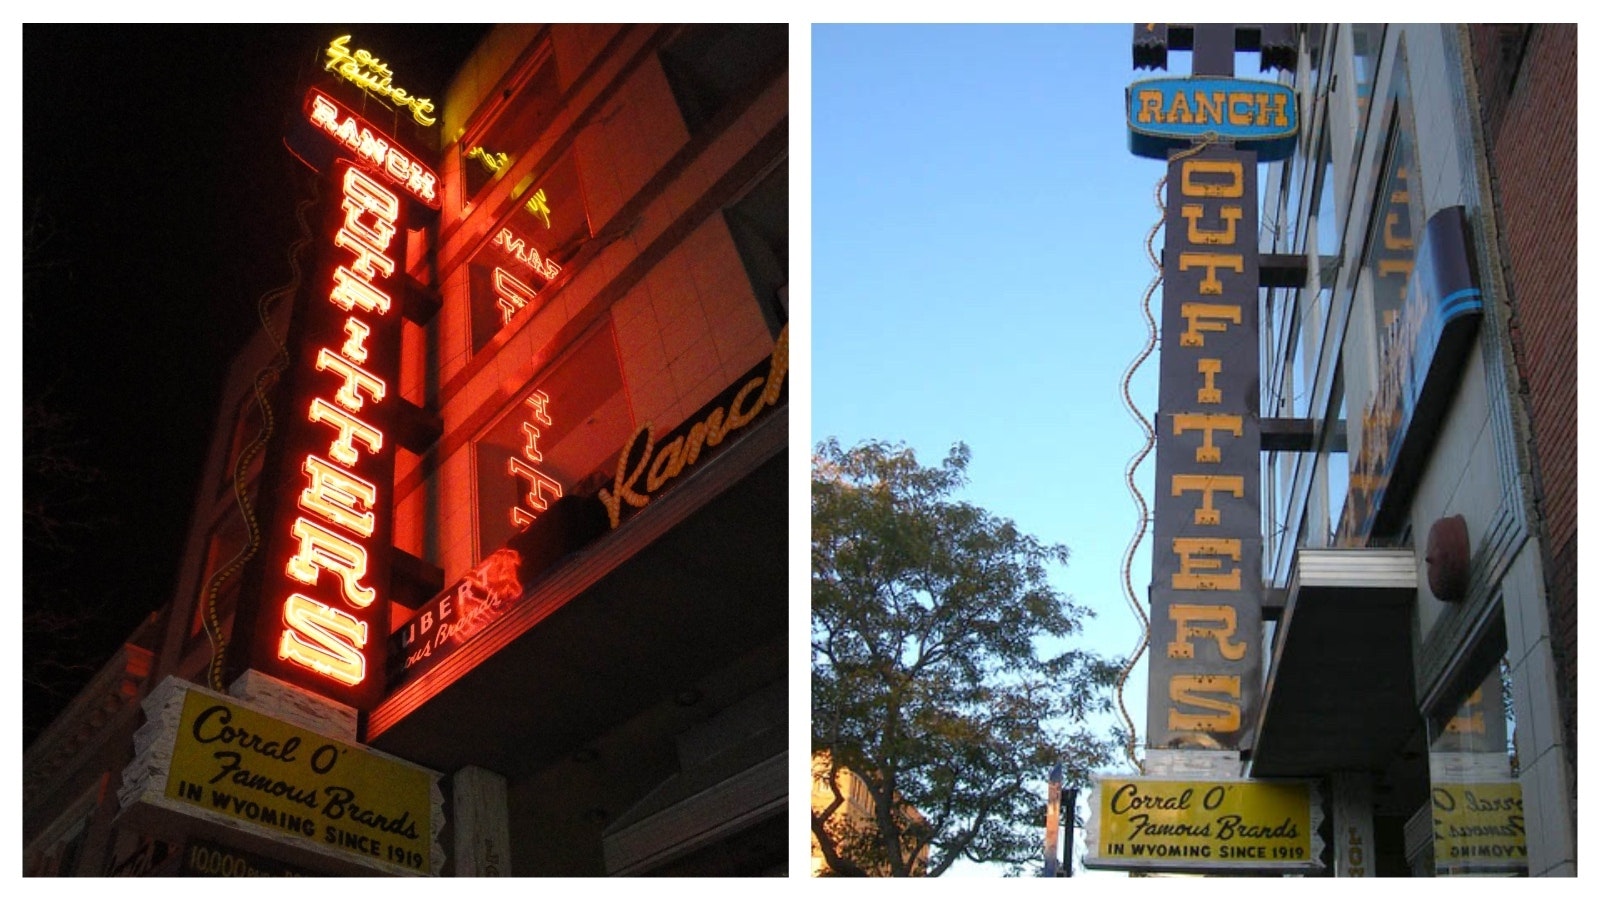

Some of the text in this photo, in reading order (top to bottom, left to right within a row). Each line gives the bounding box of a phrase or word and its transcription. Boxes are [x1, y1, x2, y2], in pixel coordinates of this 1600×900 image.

[1138, 89, 1288, 127] RANCH
[310, 94, 436, 204] RANCH
[277, 167, 399, 686] OUTFITTERS
[1167, 160, 1247, 732] OUTFITTERS
[193, 705, 302, 763] Corral
[178, 780, 424, 869] IN WYOMING SINCE 1919
[209, 751, 419, 840] Famous Brands
[1111, 784, 1194, 814] Corral
[1128, 814, 1298, 840] Famous Brands
[1107, 843, 1305, 858] IN WYOMING SINCE 1919
